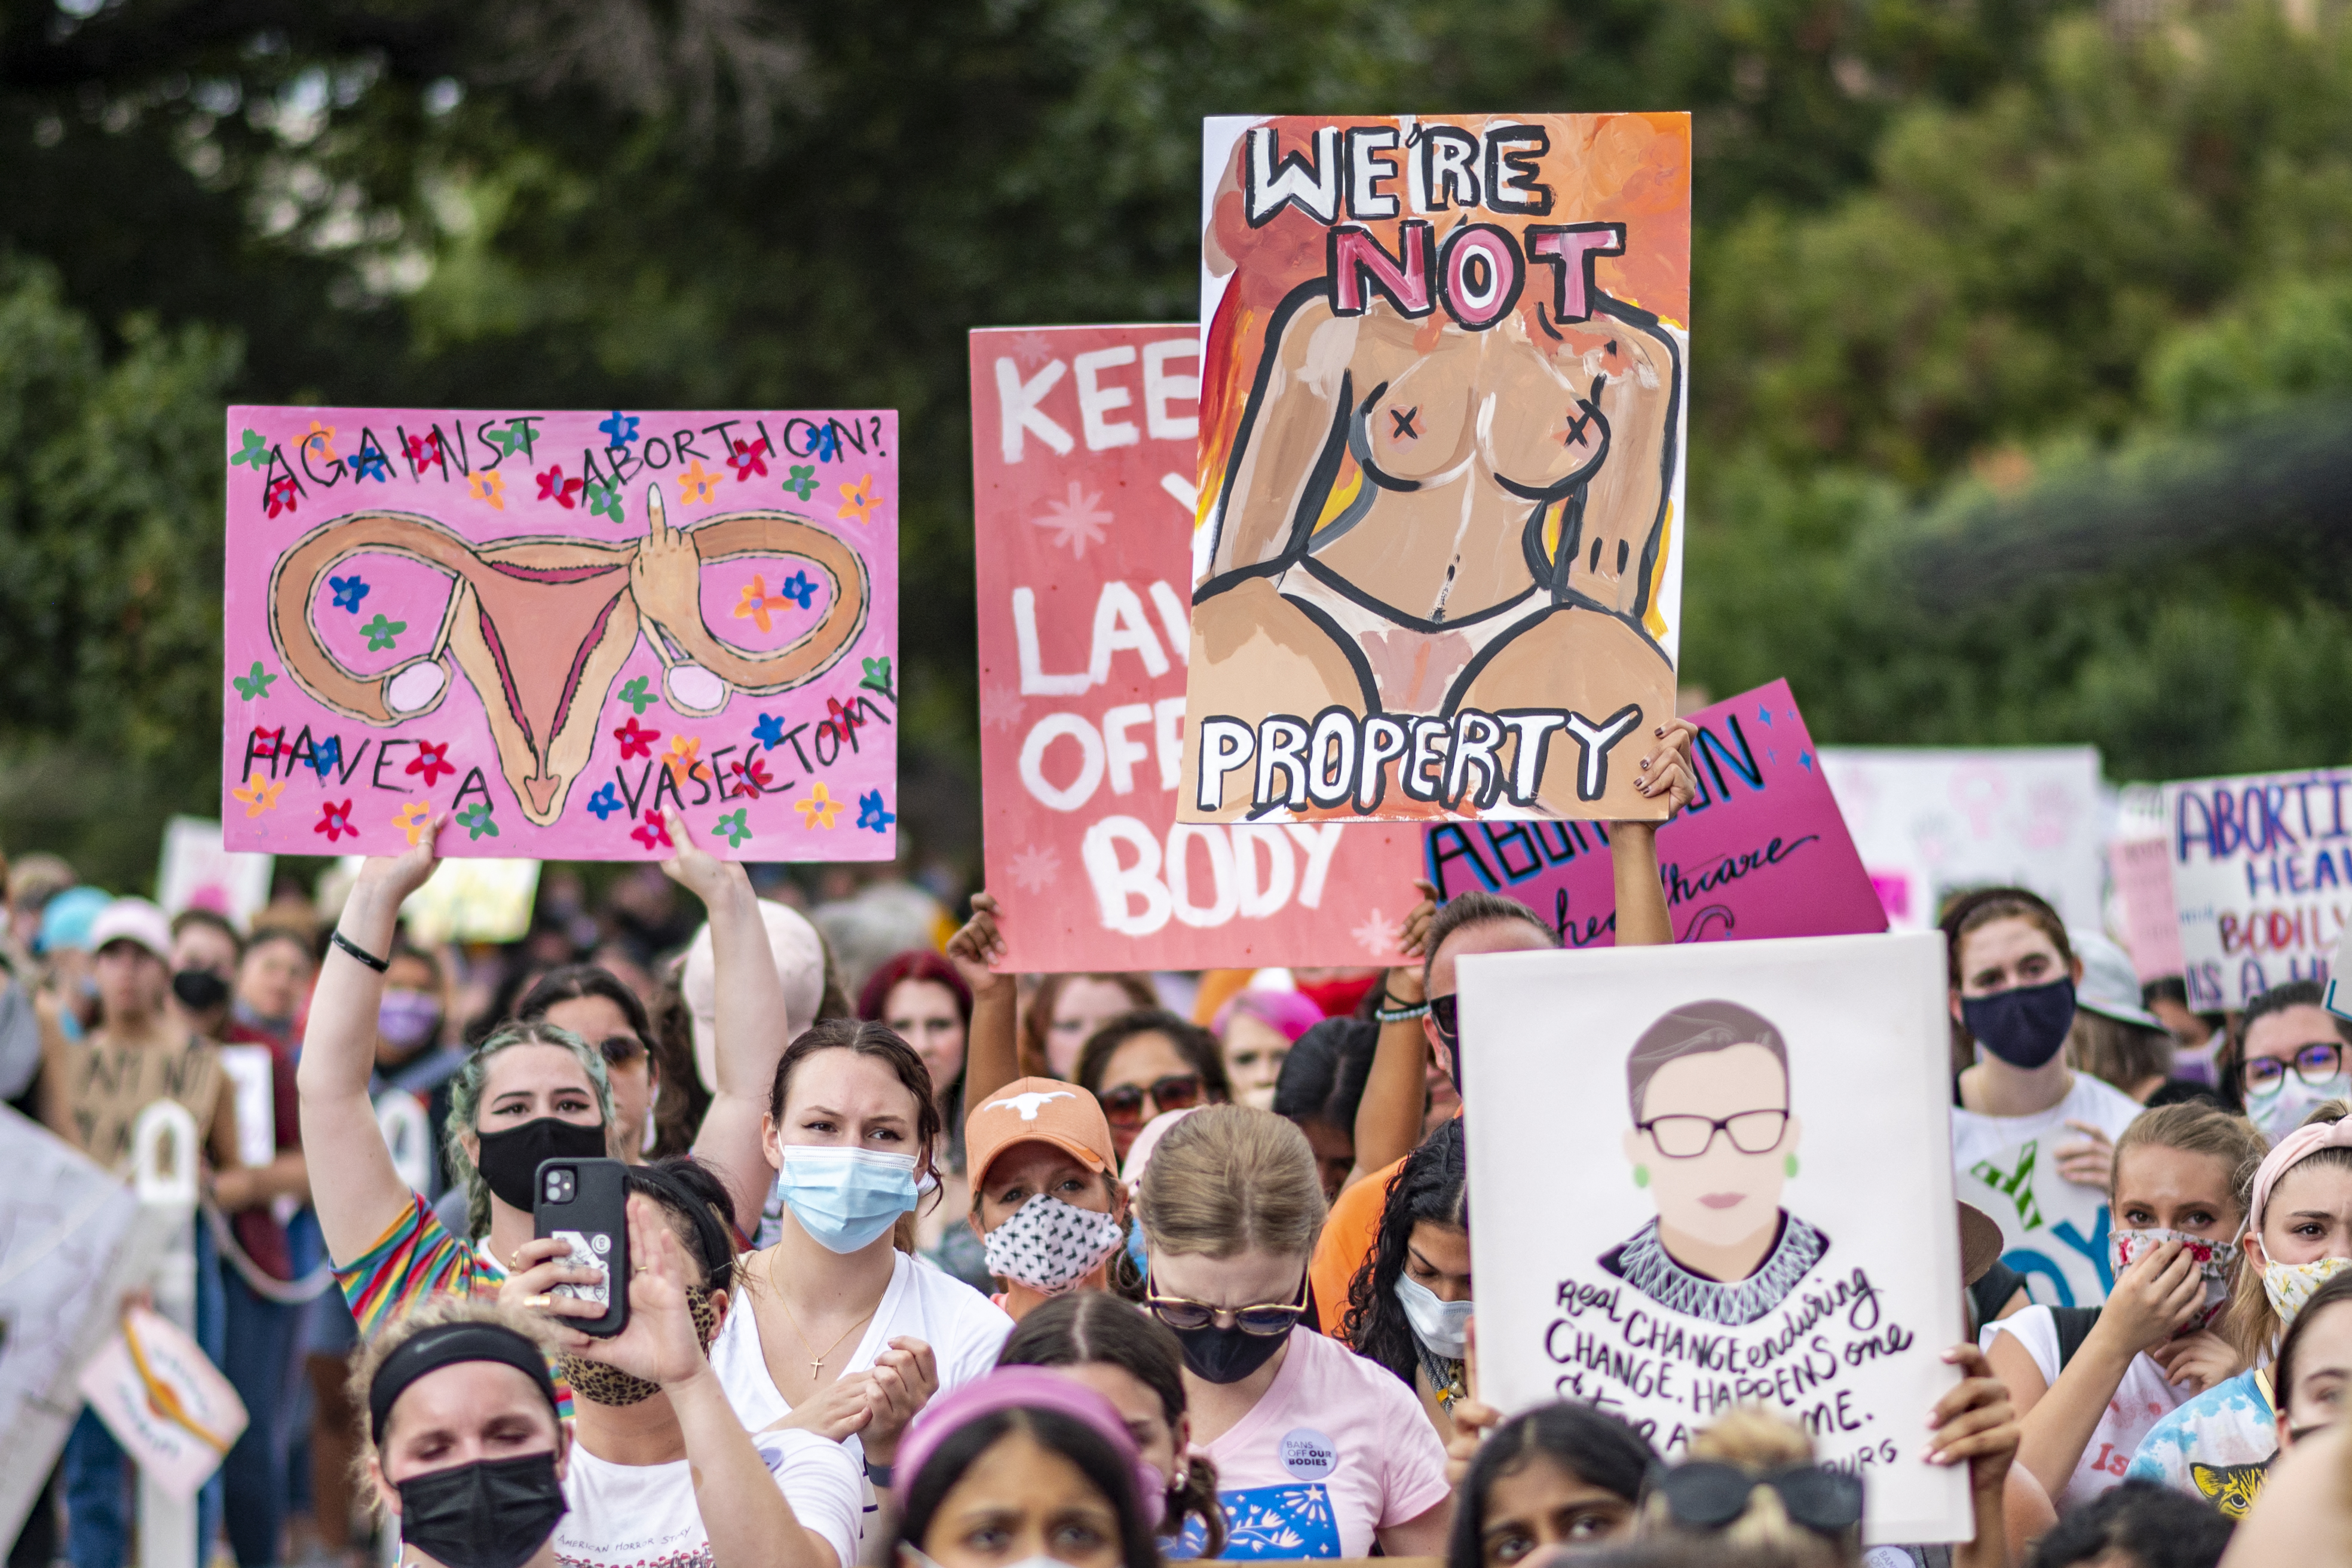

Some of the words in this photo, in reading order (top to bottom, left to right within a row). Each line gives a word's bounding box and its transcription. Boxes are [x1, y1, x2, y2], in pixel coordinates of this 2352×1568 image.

[1245, 124, 1557, 229] WE'RE
[1327, 218, 1627, 332] NOT
[263, 416, 545, 512] AGAINST
[581, 416, 887, 508] ABORTION?
[241, 724, 423, 794] HAVE
[451, 766, 495, 813] A
[616, 665, 898, 820] VASECTOMY
[1196, 701, 1644, 822] PROPERTY
[1082, 814, 1345, 937] BODY
[2188, 960, 2223, 1003] IS
[2240, 958, 2267, 1000] A
[1747, 1267, 1884, 1368] enduring
[1845, 1323, 1915, 1366] one
[1287, 1441, 1313, 1449] BANS
[1288, 1458, 1327, 1466] BODIES
[1309, 1450, 1331, 1458] OUR
[557, 1534, 610, 1553] AMERICAN
[615, 1538, 655, 1552] HORROR
